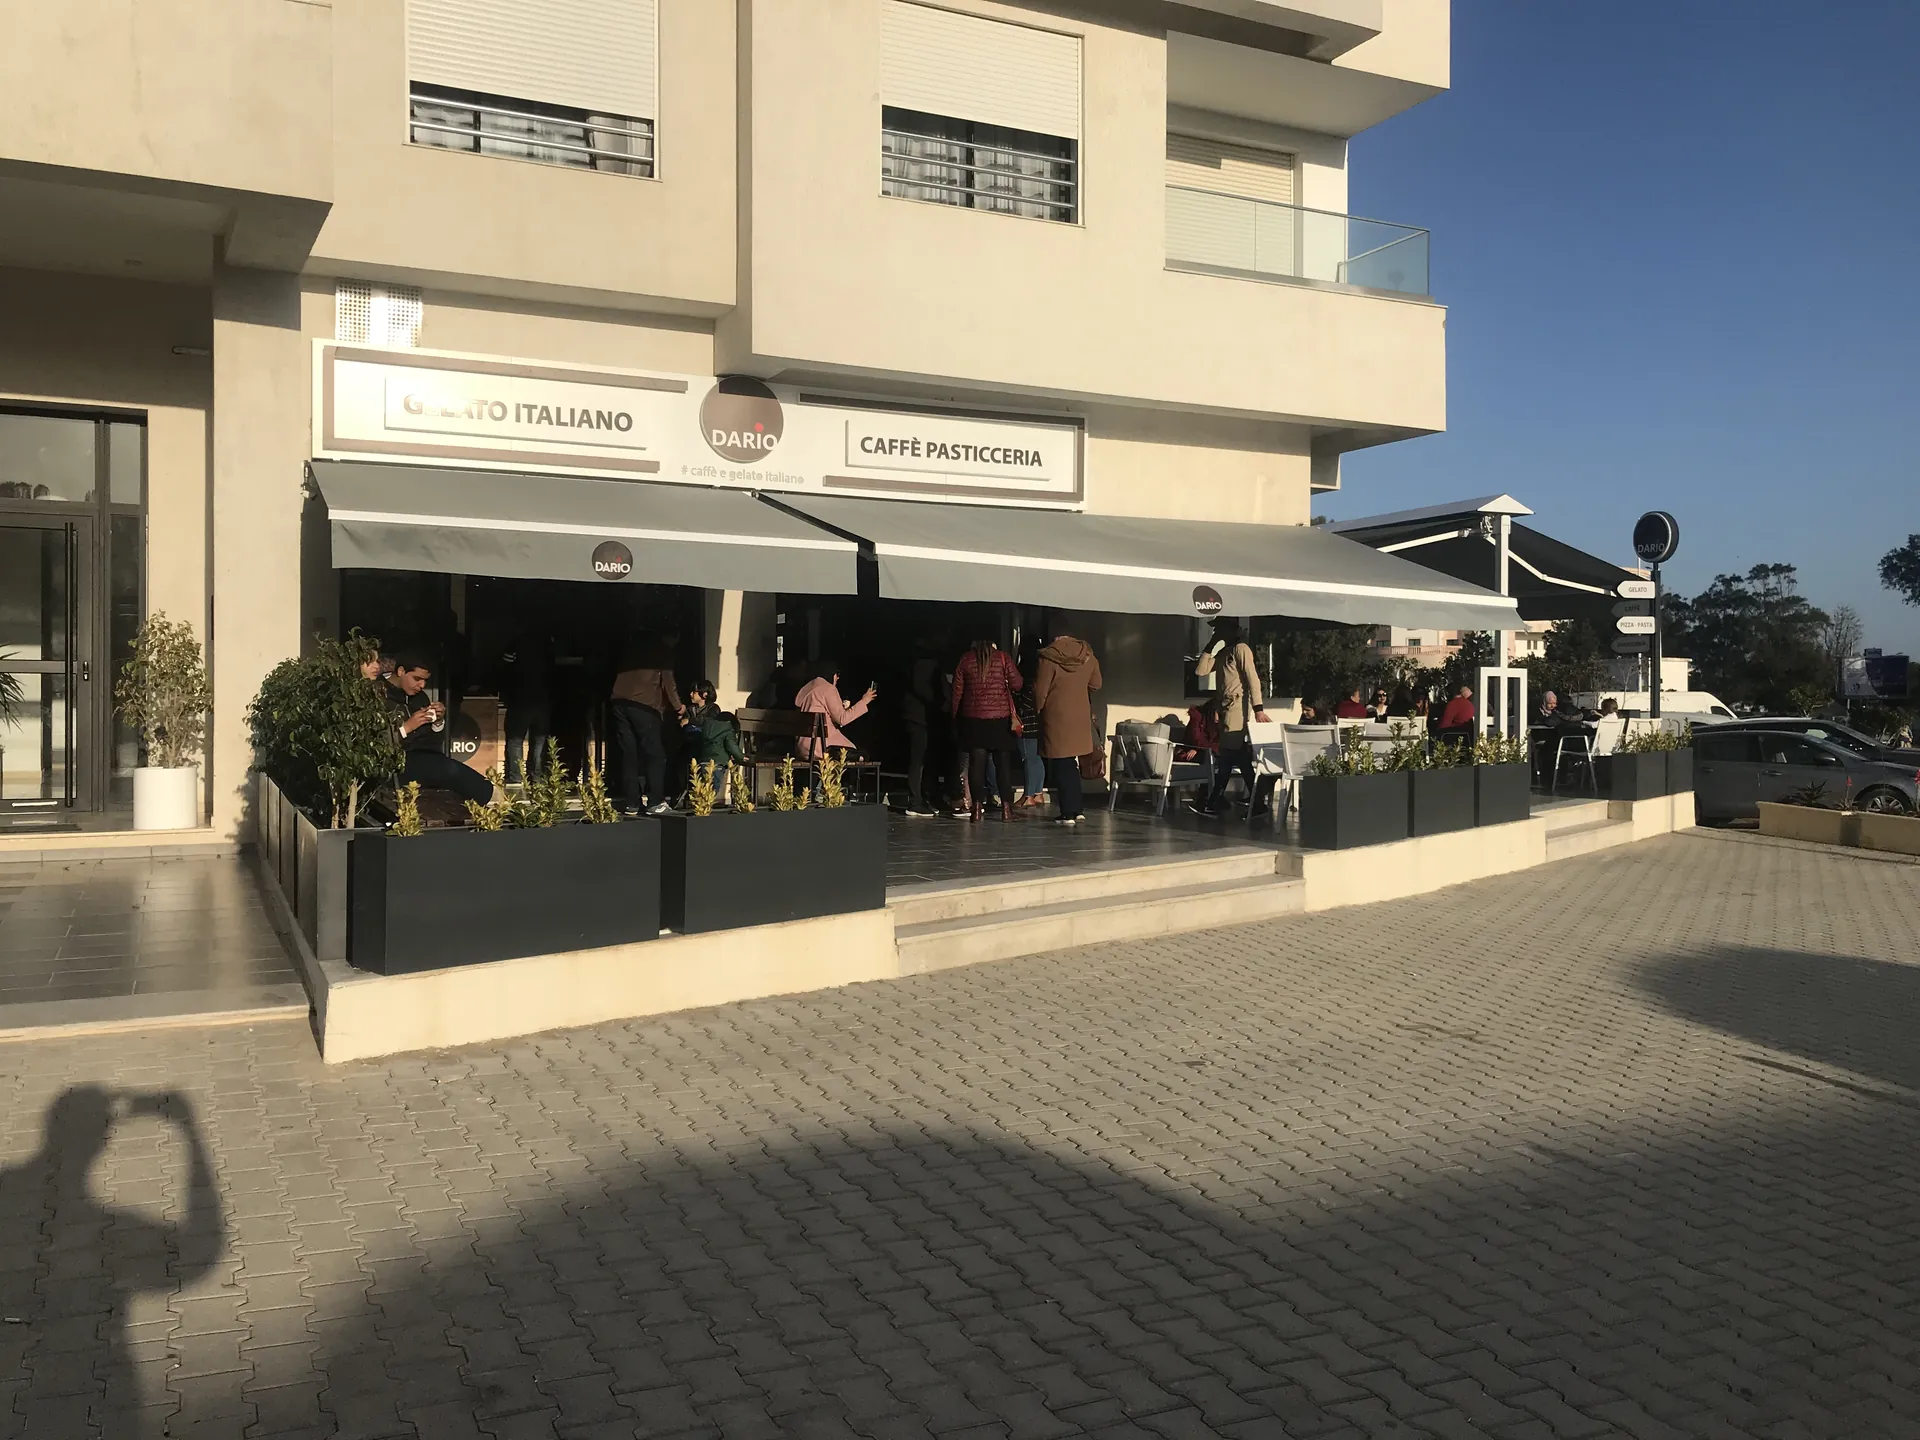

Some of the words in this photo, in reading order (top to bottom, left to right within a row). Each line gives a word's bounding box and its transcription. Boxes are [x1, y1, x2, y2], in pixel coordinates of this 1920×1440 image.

[514, 402, 634, 432] ITALIANO
[712, 430, 777, 450] DARIO
[860, 436, 922, 458] CAFFÈ
[926, 441, 1043, 467] PASTICCERIA
[690, 466, 717, 478] caffè
[728, 469, 763, 481] gelato
[765, 471, 805, 484] italiano
[1637, 543, 1665, 552] DARIO
[595, 561, 631, 573] DARIO
[1195, 601, 1222, 610] DARIO
[450, 742, 476, 752] RIO
